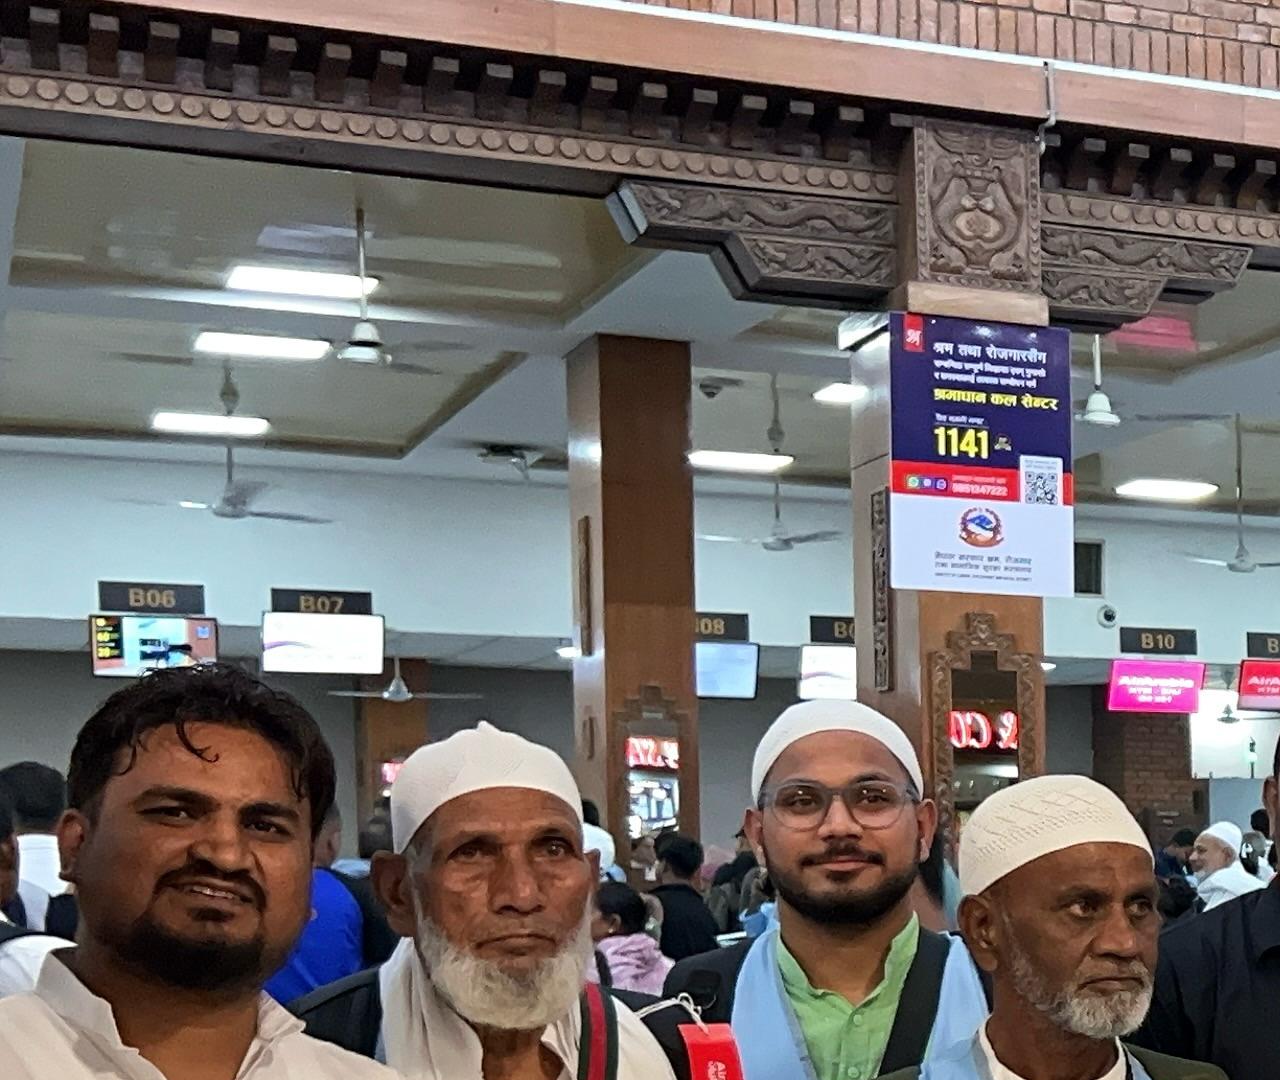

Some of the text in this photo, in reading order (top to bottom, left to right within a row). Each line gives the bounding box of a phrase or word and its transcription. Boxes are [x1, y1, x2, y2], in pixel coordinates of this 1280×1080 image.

[934, 426, 989, 460] 1141
[128, 587, 176, 608] B06
[299, 594, 344, 613] B07
[696, 618, 725, 635] 08
[1141, 633, 1175, 649] B10
